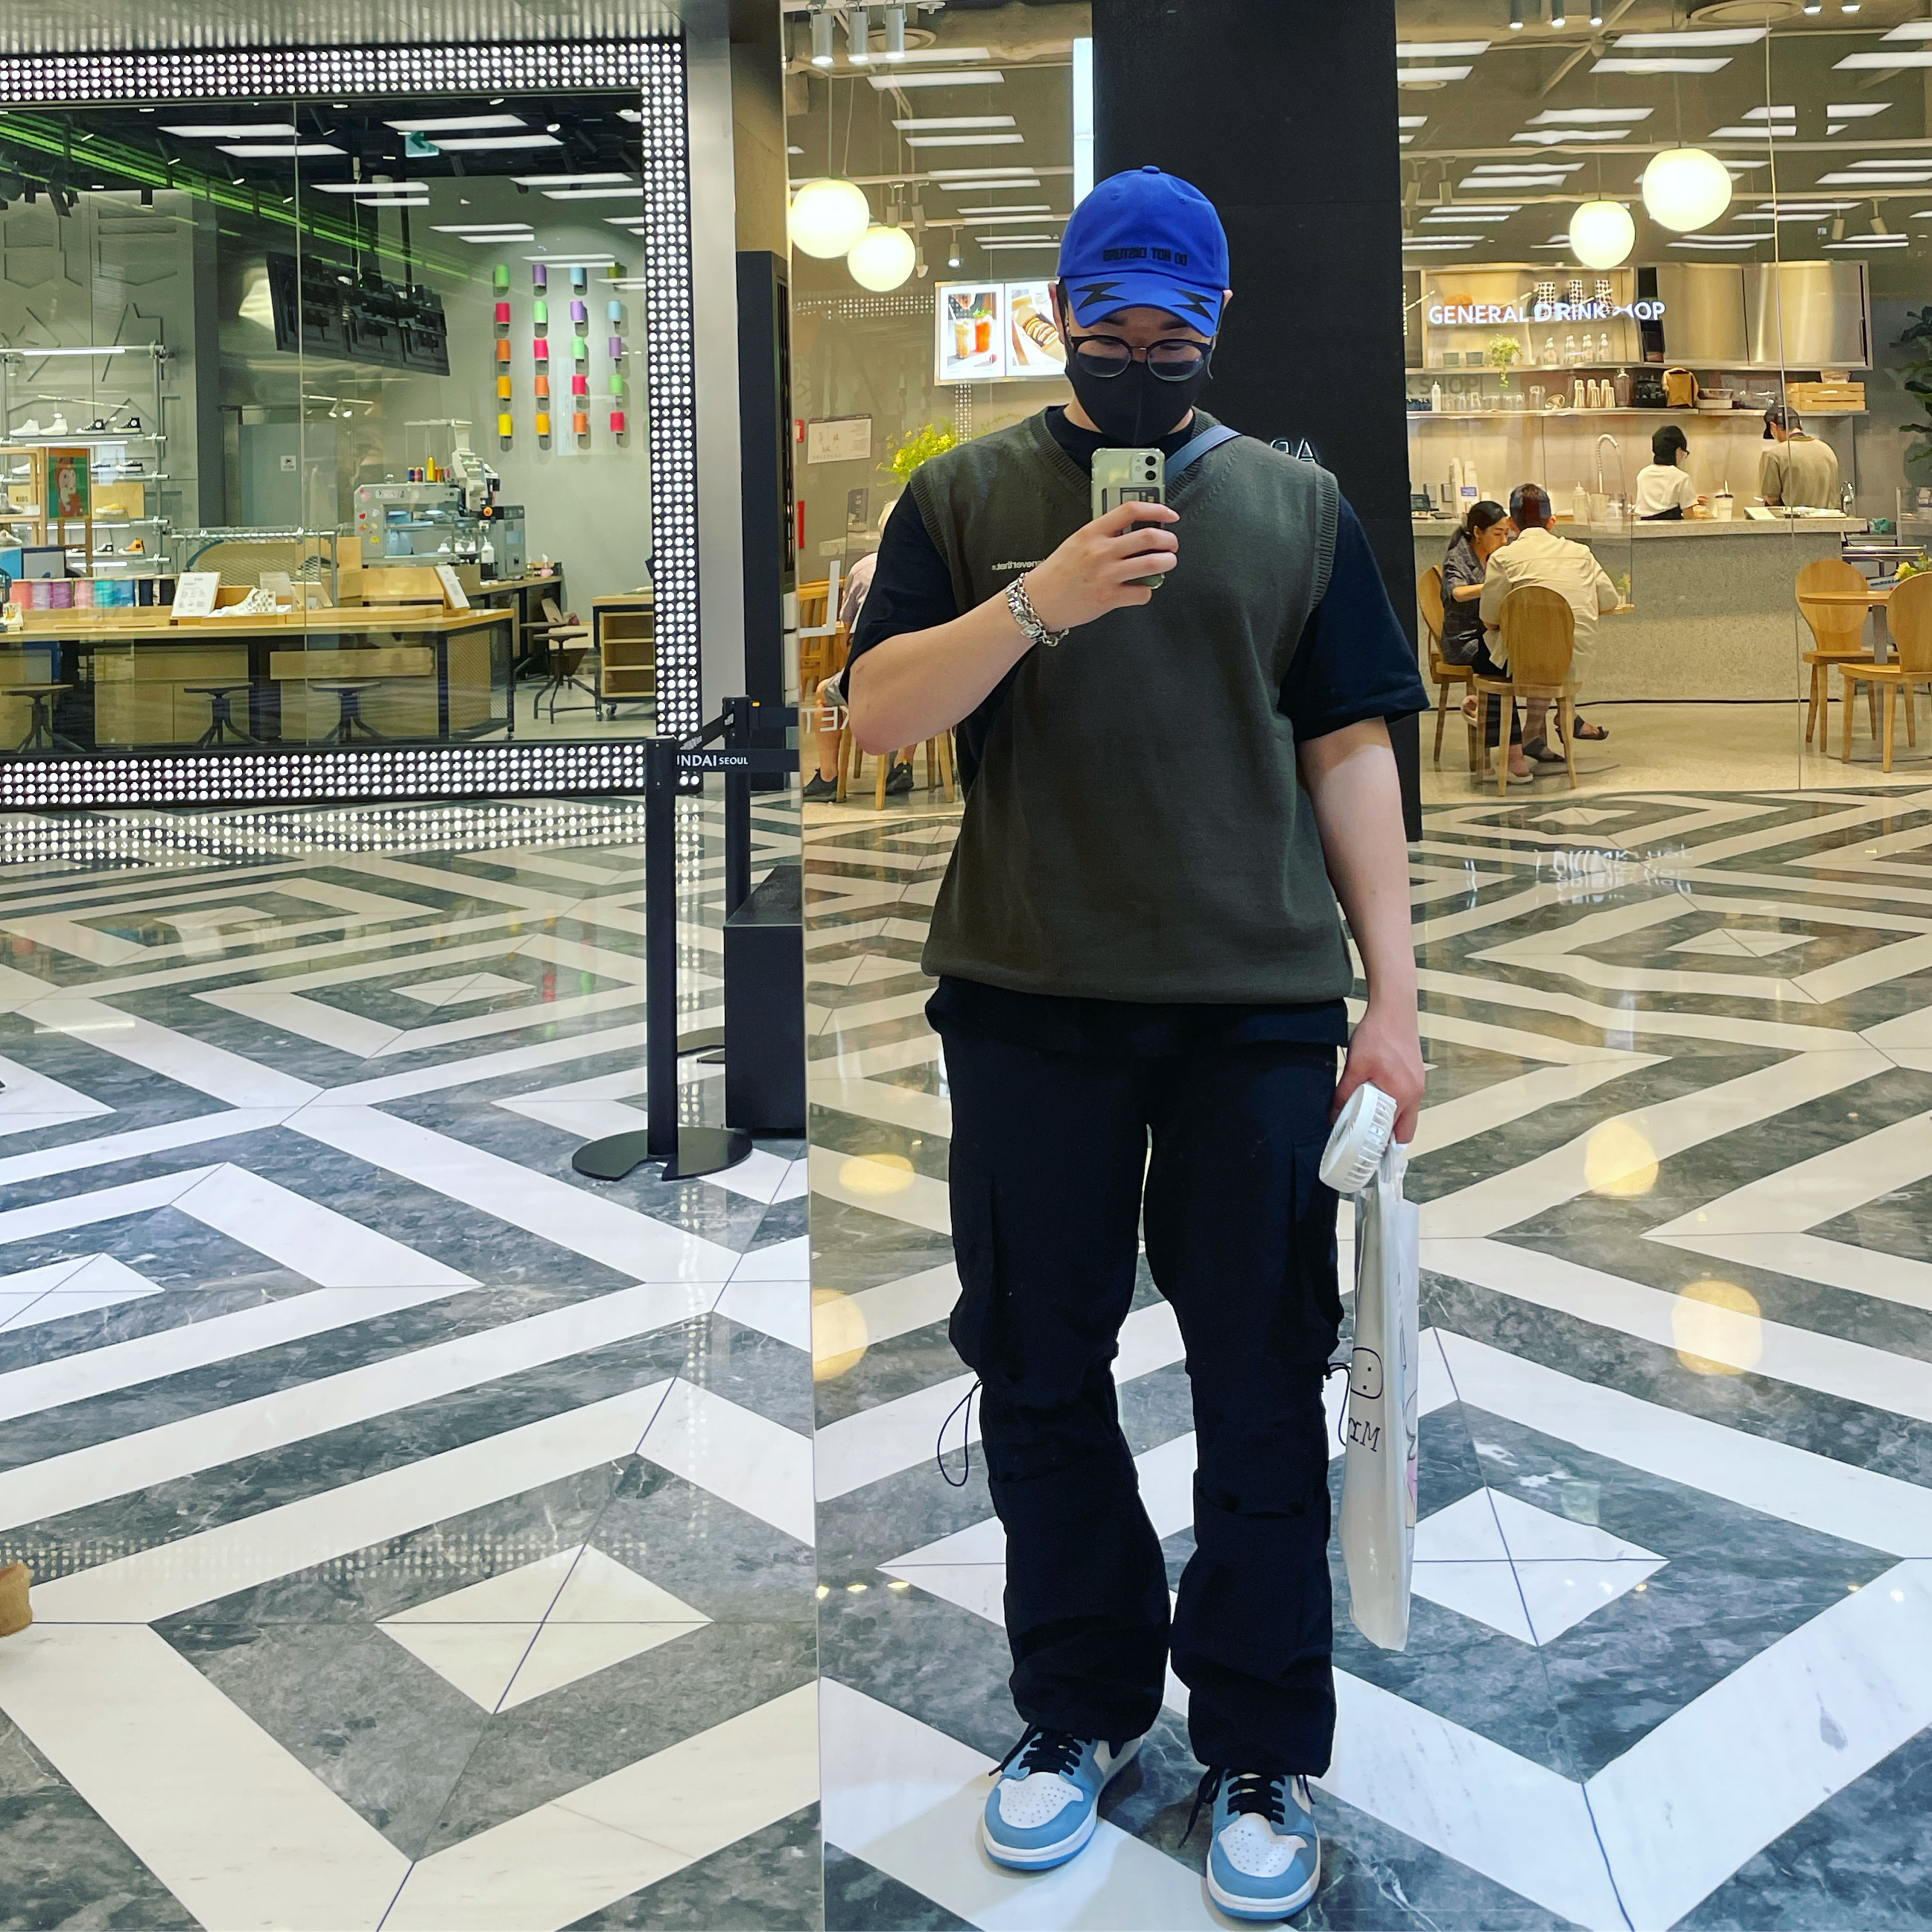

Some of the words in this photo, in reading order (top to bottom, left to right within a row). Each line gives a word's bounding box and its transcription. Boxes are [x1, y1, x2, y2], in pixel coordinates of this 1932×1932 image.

[1429, 304, 1529, 325] GENERAL
[1534, 302, 1607, 322] DRINK
[719, 756, 749, 765] SEOUL
